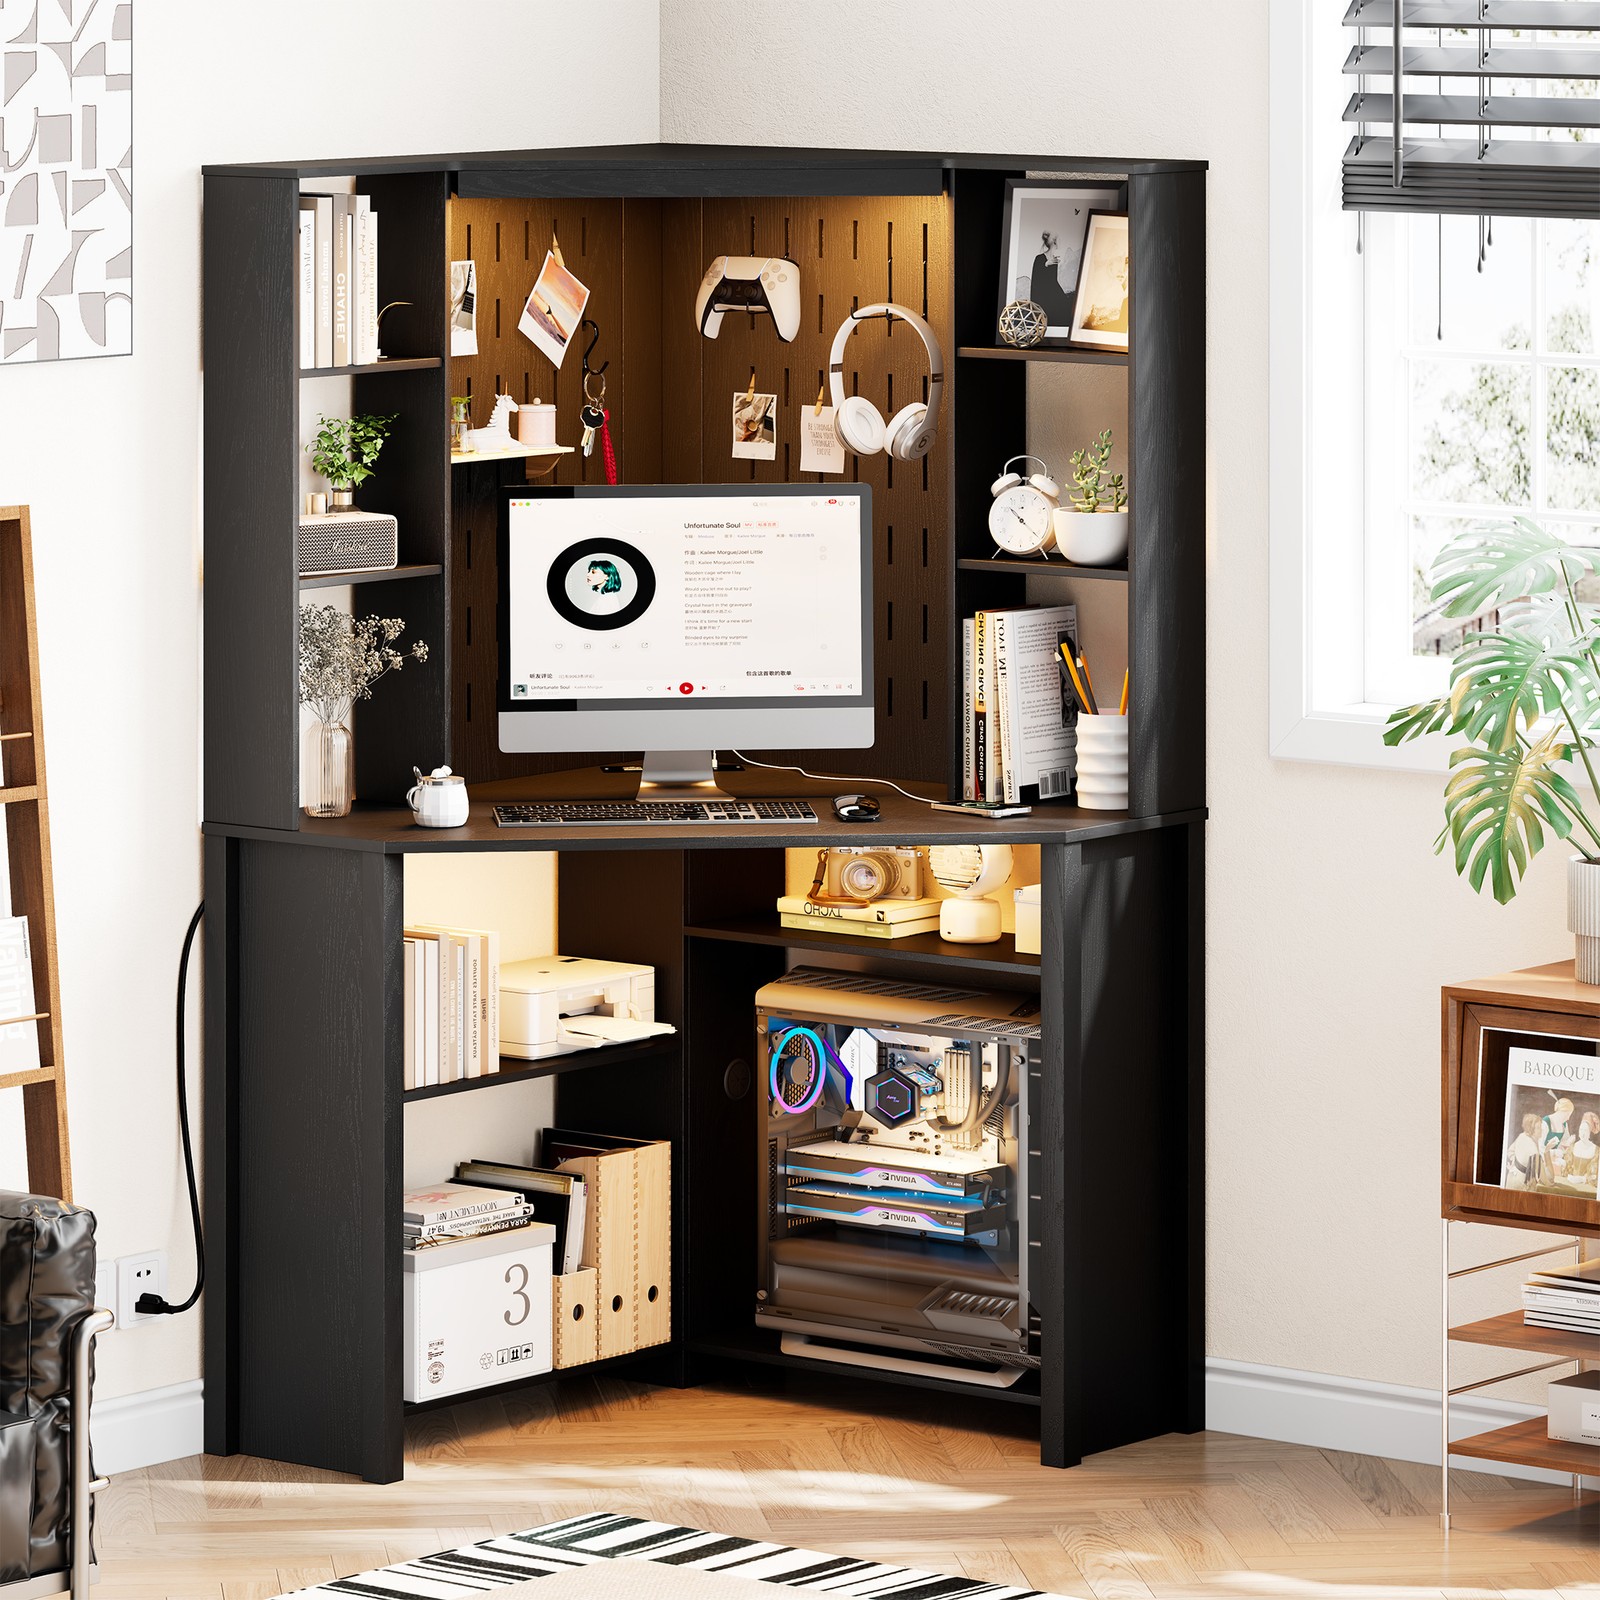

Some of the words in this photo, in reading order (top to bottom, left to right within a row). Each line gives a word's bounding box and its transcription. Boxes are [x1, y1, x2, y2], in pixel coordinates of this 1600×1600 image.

[804, 902, 842, 918] TYCHO
[1523, 1060, 1594, 1082] BAROQUE
[891, 1175, 916, 1184] NVIDIA
[448, 1201, 498, 1218] MOOVEMENT
[510, 1218, 528, 1226] SARA
[891, 1214, 916, 1223] NVIDIA
[504, 1263, 532, 1326] 3
